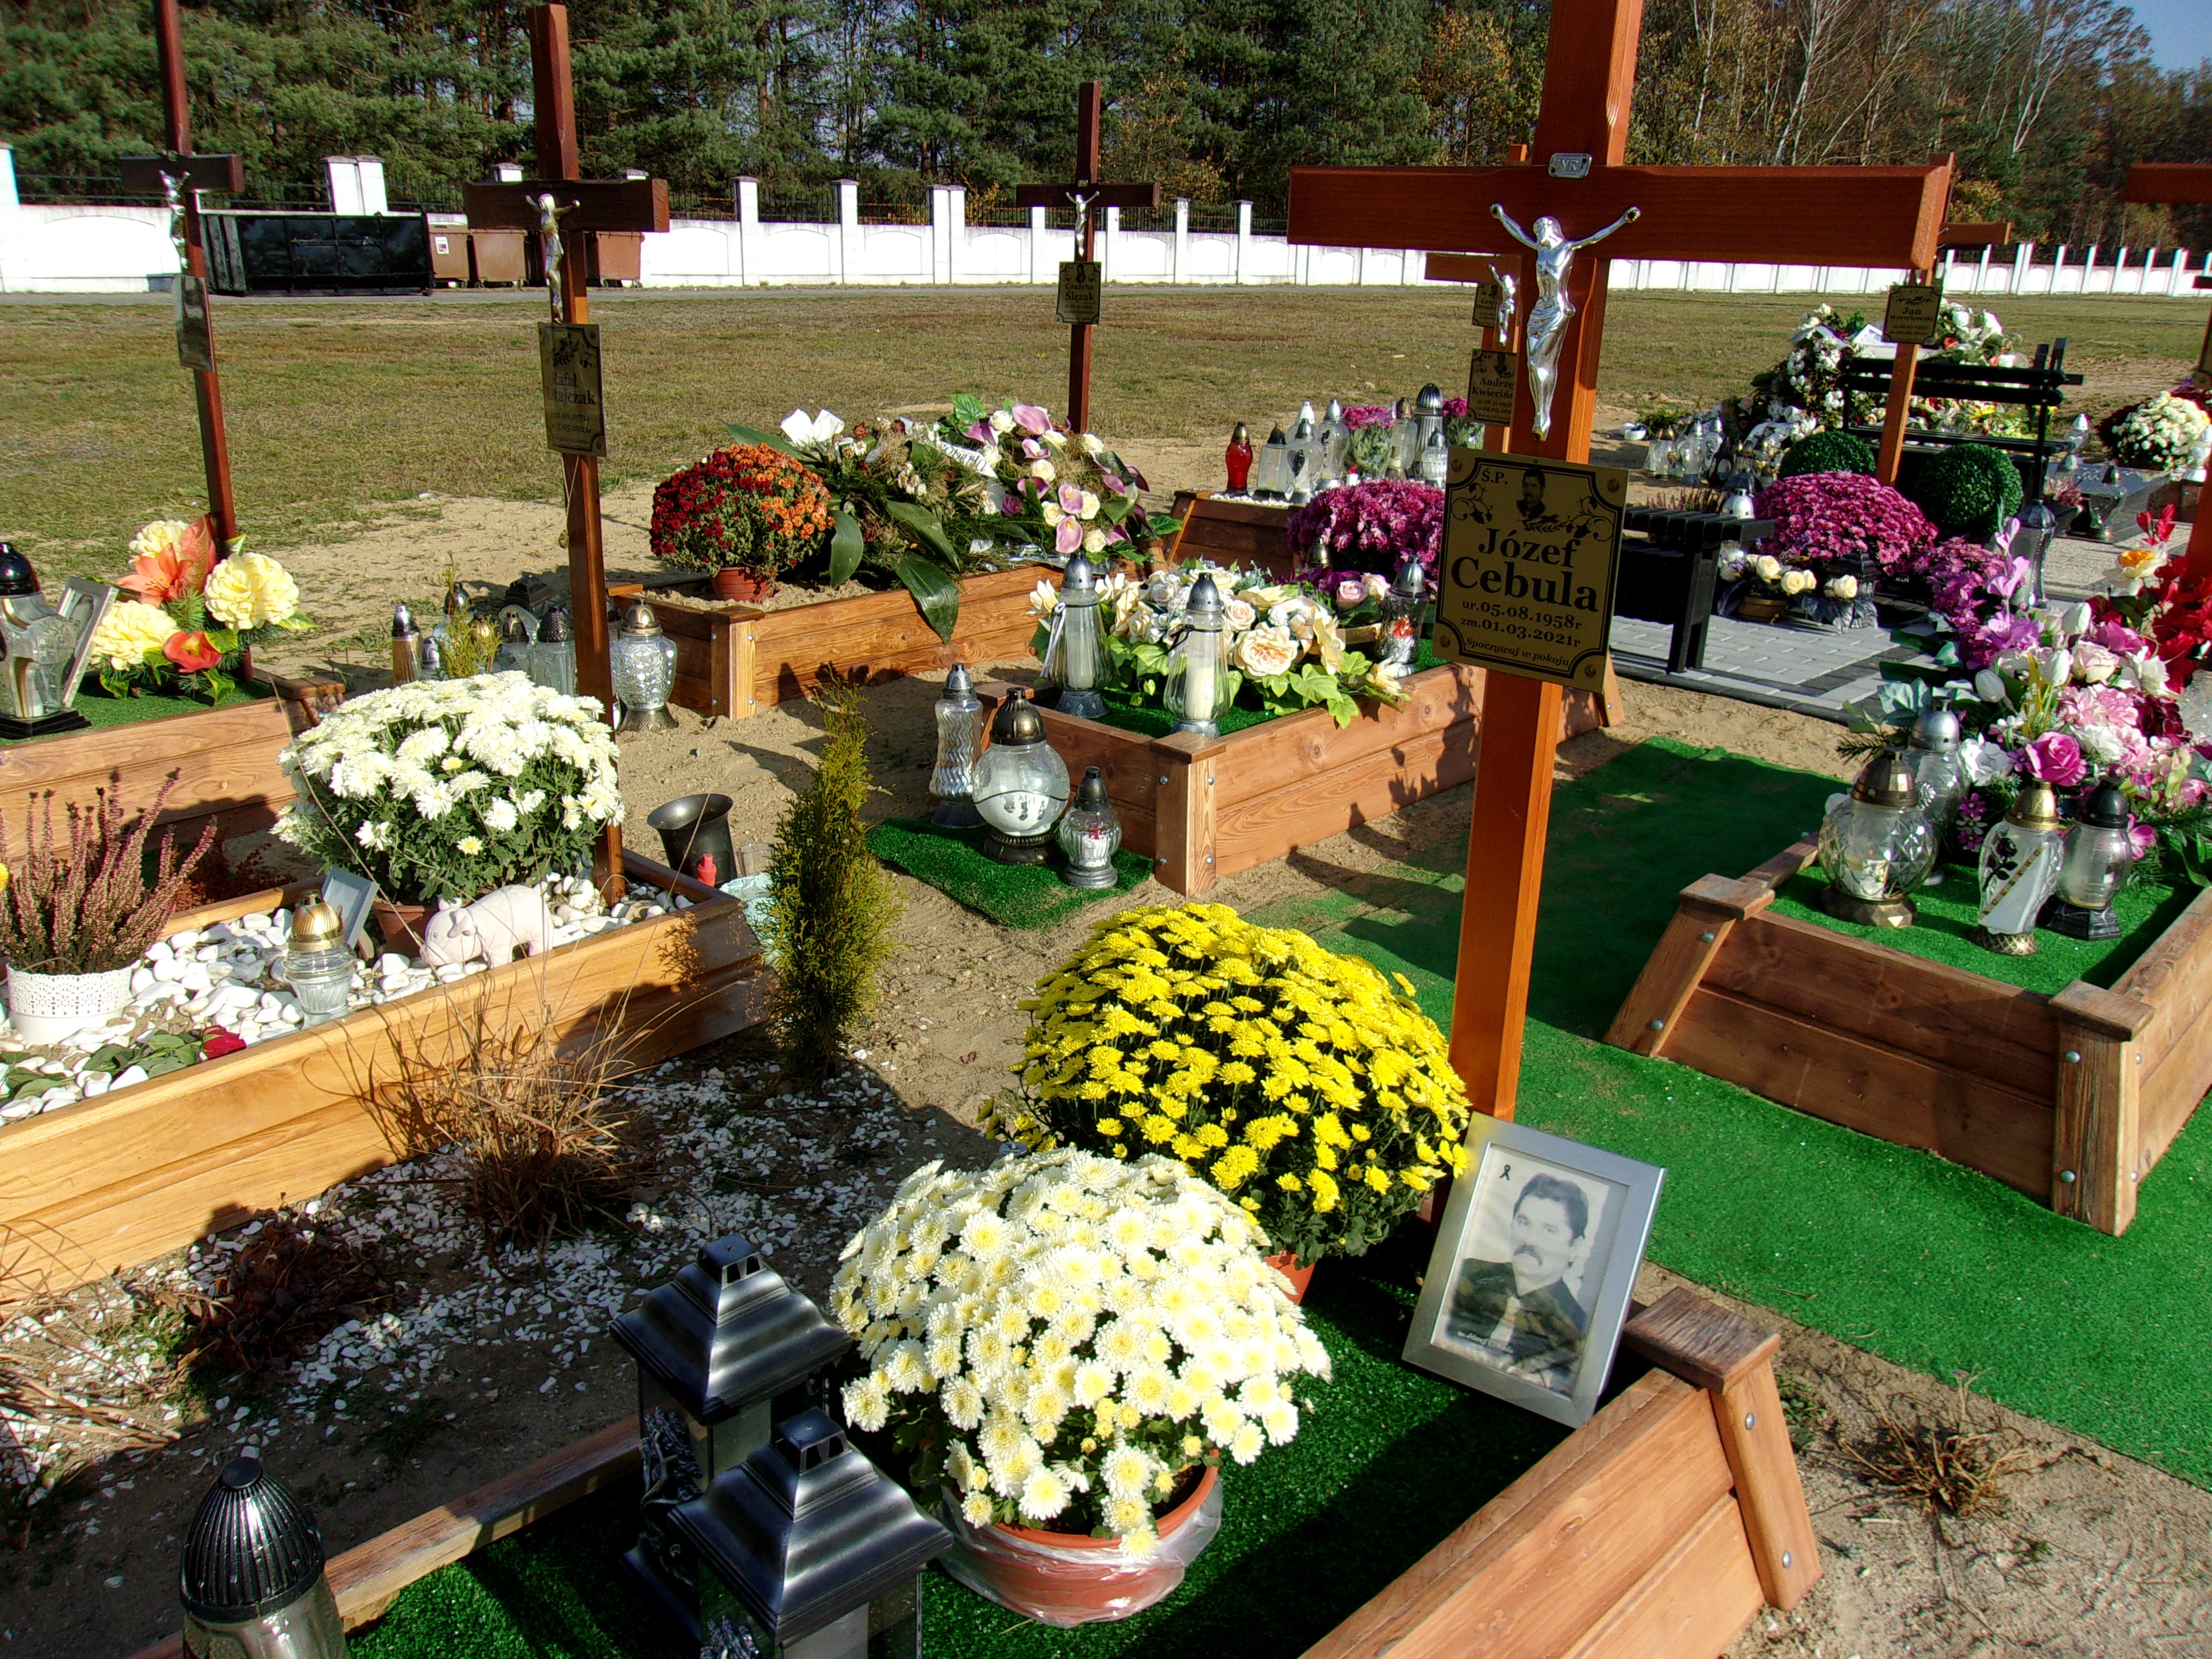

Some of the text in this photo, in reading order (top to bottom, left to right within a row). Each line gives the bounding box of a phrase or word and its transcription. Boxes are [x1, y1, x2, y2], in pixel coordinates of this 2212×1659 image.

[1479, 377, 1514, 388] Andrze
[1478, 528, 1581, 568] Józef
[1451, 556, 1599, 613] Cebula
[1462, 600, 1582, 630] ur.05.08.1958r
[1461, 616, 1581, 648] zm.01.03.2021r
[1466, 637, 1519, 657] Spoczywaj
[1532, 651, 1570, 667] pokoju
